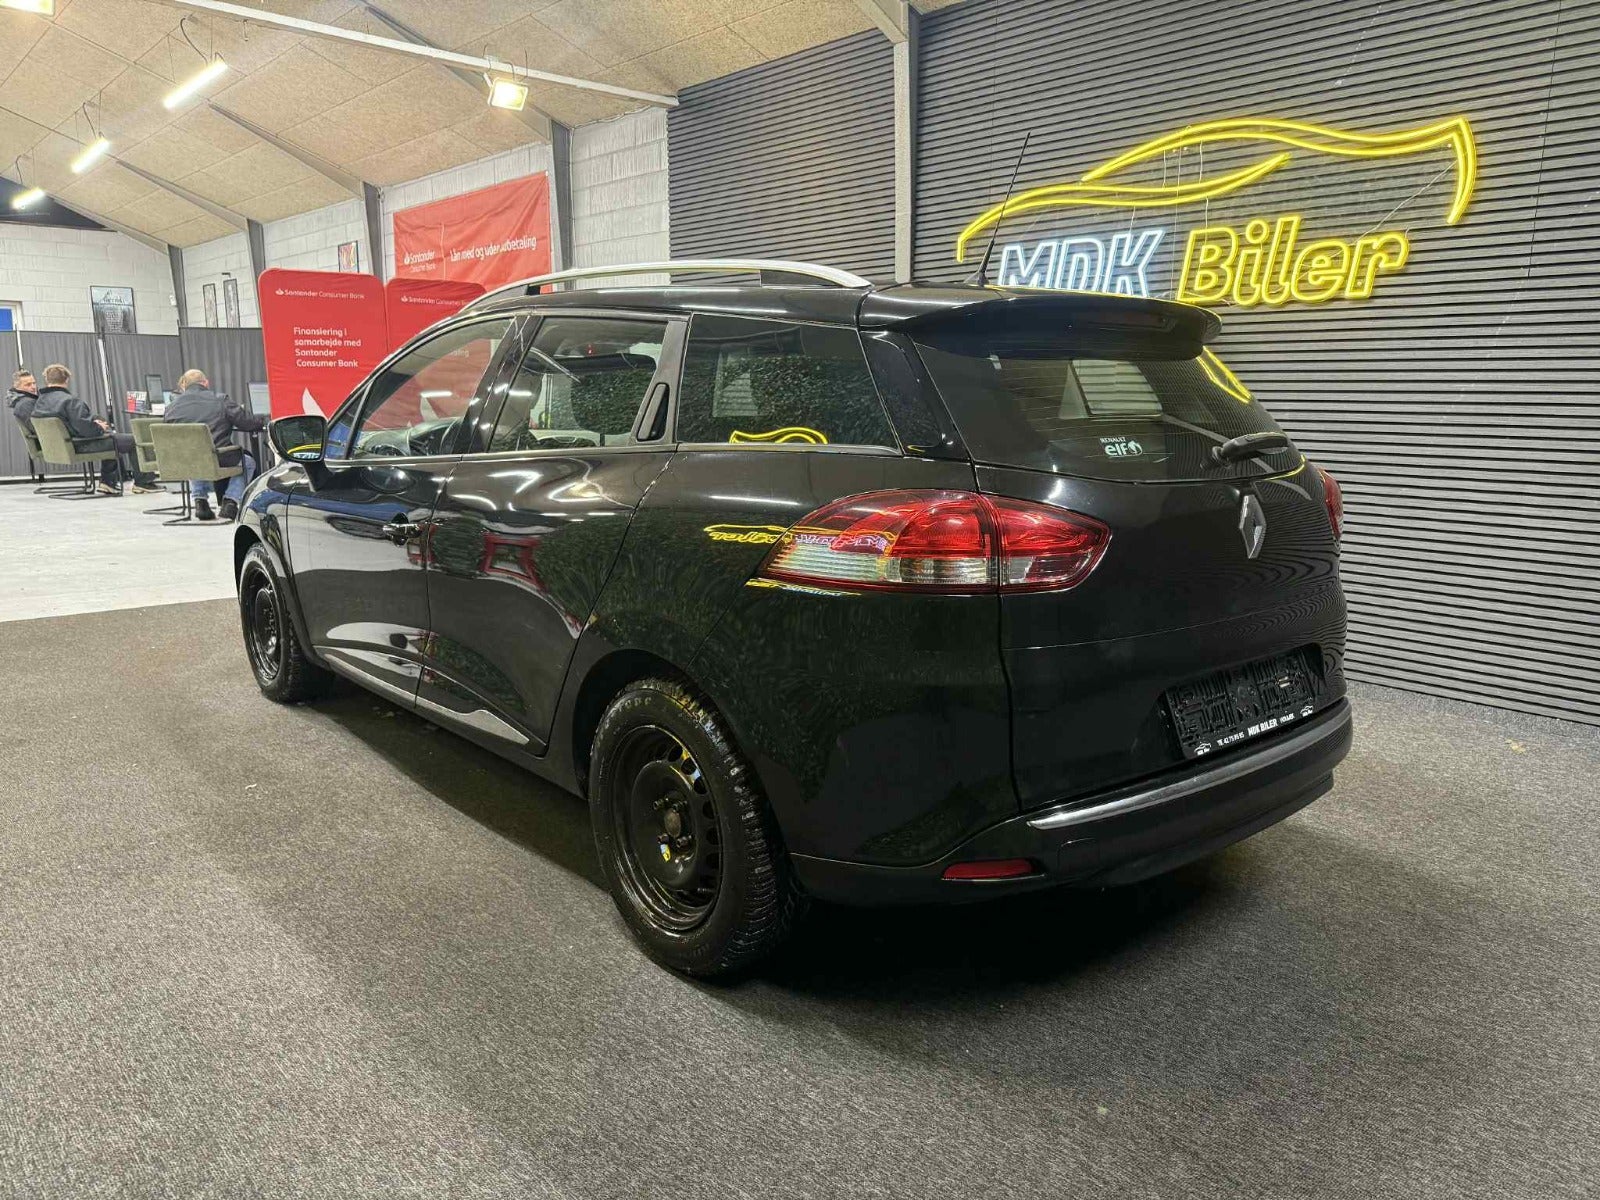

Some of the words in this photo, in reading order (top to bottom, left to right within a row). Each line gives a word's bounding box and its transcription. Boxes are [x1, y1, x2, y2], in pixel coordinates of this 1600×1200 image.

[461, 245, 474, 260] med
[475, 247, 485, 261] og
[999, 229, 1164, 297] MDK
[1177, 217, 1409, 306] Biler
[284, 289, 318, 297] Santander
[319, 291, 348, 299] Consumer
[294, 327, 343, 338] Finansiering
[294, 338, 342, 348] samarbejde
[343, 339, 361, 347] med
[295, 348, 337, 357] Santander
[296, 359, 336, 367] Consumer
[338, 359, 358, 367] Bank
[1260, 718, 1278, 732] BILER
